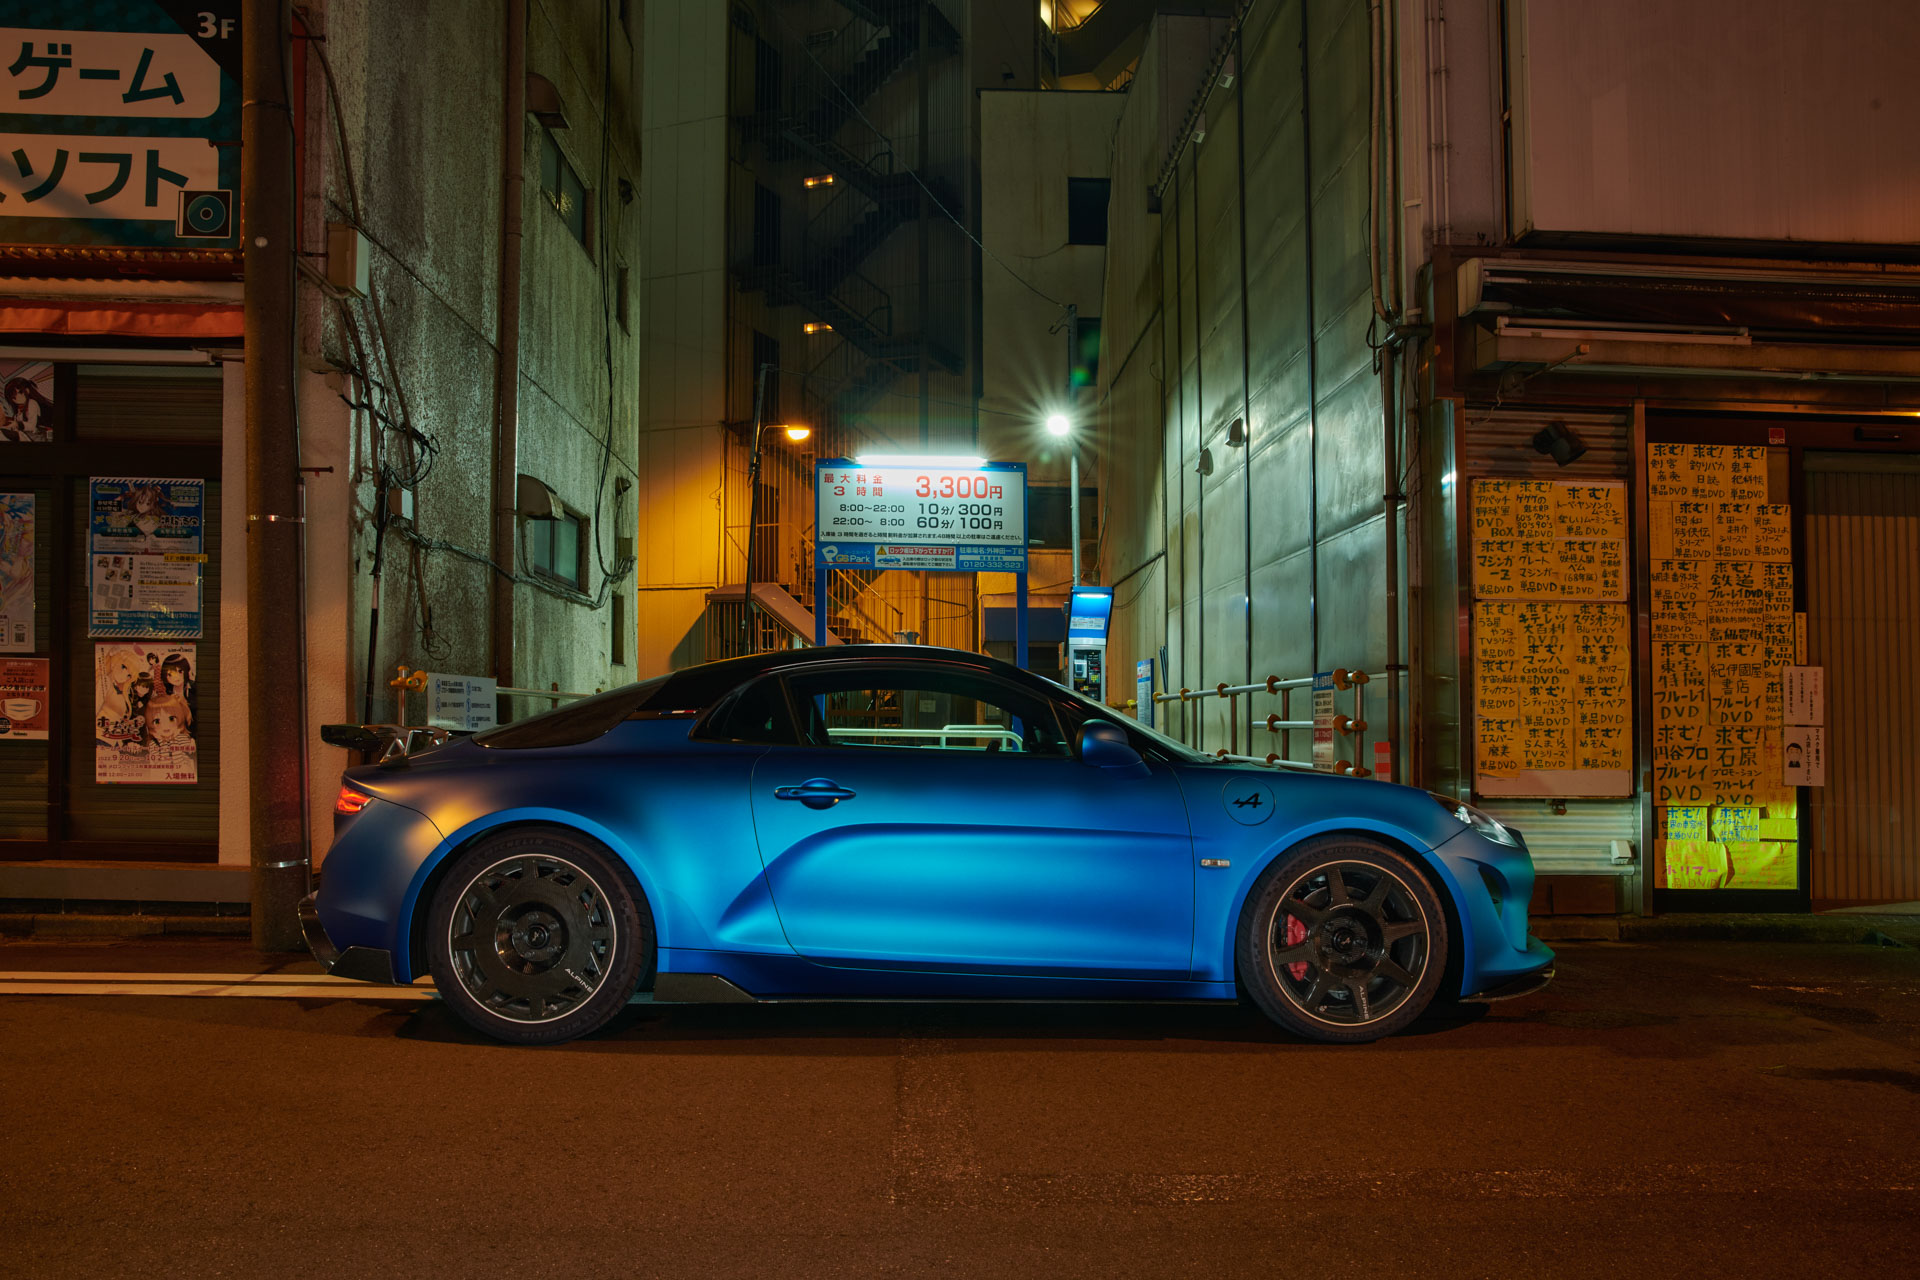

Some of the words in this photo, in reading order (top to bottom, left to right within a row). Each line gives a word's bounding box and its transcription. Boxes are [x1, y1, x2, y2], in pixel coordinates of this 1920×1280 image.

[197, 12, 235, 39] 3F
[8, 42, 185, 105] ゲーム
[0, 149, 189, 208] ソフト
[824, 473, 883, 484] 最大料金
[916, 475, 1003, 499] 3,300円
[1582, 635, 1615, 644] DVD
[1660, 706, 1700, 720] DVD
[1721, 711, 1753, 723] DVD
[1716, 746, 1757, 767] 石原
[165, 772, 196, 780] 入場無料
[1660, 785, 1702, 801] DVD
[1716, 794, 1754, 805] DVD
[565, 968, 594, 993] ALPINE
[1358, 985, 1370, 1020] ALPINE
